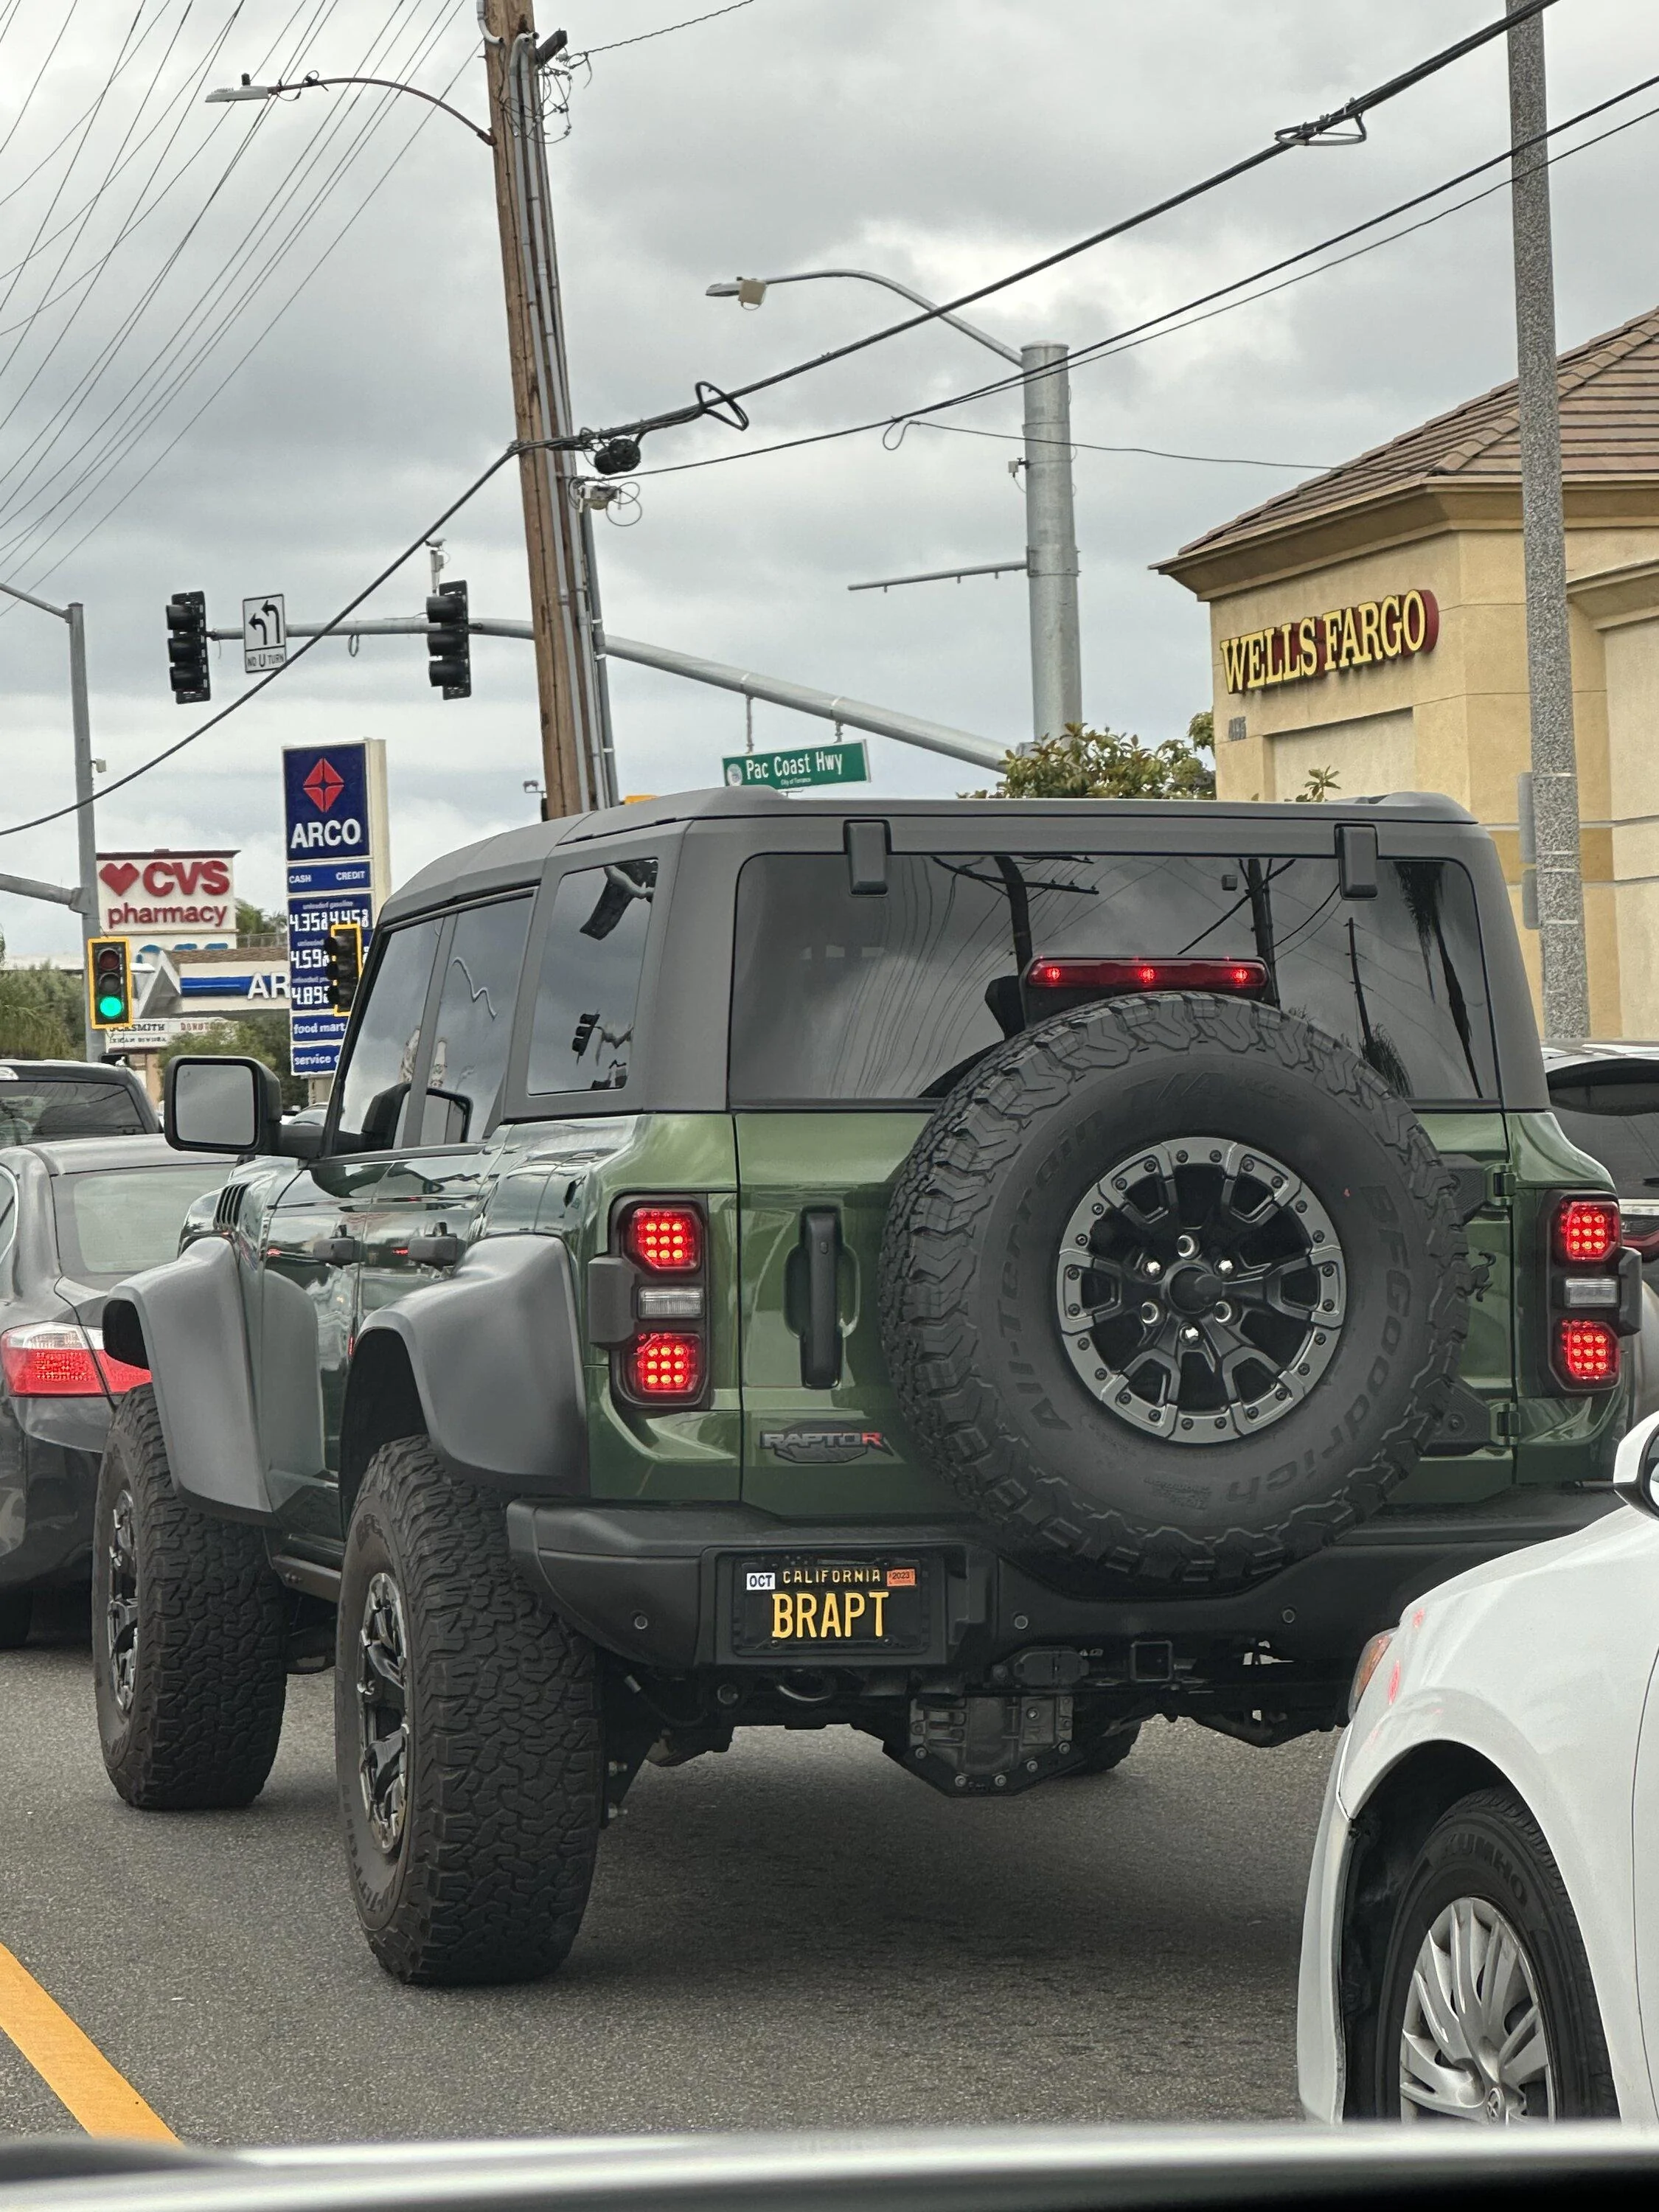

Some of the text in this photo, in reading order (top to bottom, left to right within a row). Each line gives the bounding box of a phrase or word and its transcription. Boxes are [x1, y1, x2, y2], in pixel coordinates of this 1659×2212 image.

[1220, 589, 1432, 694] WELLS FARGO
[247, 653, 285, 668] NO U TURN
[745, 751, 843, 779] Pac Coast Hwy
[291, 818, 361, 849] ARCO
[142, 860, 230, 897] CVS
[288, 871, 365, 883] CASH CREDIT
[108, 902, 227, 929] pharmacy
[248, 972, 291, 999] AR
[293, 1023, 345, 1034] food mart
[294, 1054, 331, 1065] service
[762, 1431, 888, 1455] RAPTOR
[749, 1575, 772, 1588] OCT
[782, 1568, 880, 1584] CALIFORNIA
[892, 1571, 910, 1579] 2023
[772, 1591, 889, 1638] BRAPT
